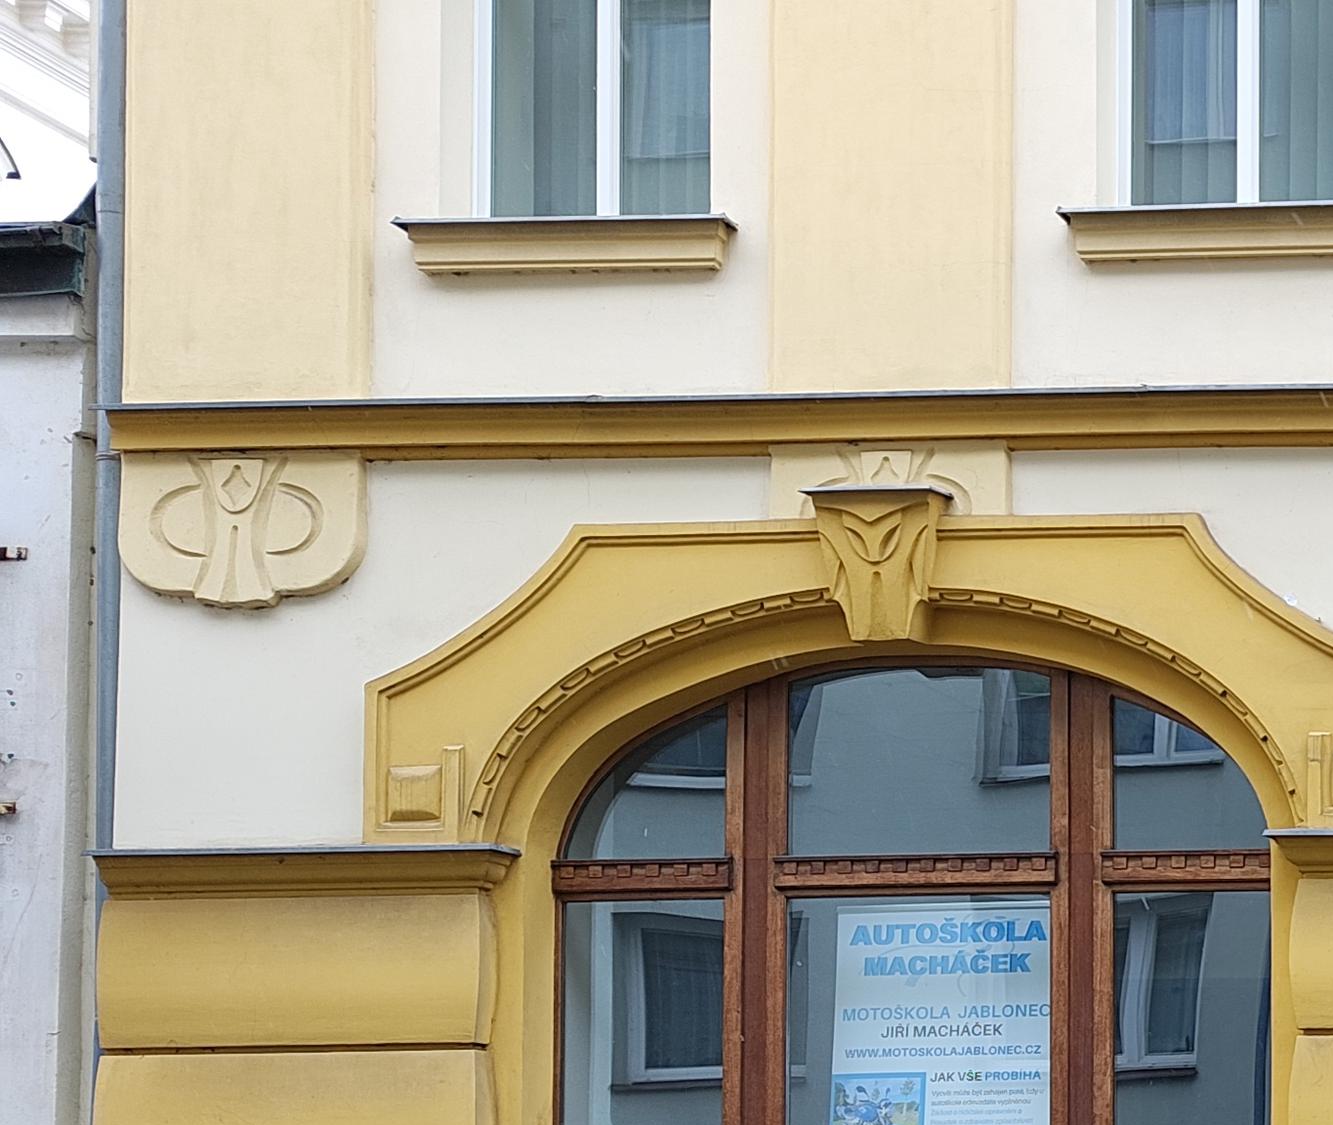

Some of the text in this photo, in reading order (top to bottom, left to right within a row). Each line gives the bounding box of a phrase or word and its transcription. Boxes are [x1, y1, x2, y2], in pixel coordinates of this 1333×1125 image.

[850, 918, 1047, 946] AUTOŠKOLA
[864, 949, 1031, 976] MACHÁČEK
[842, 1004, 1050, 1021] MOTOŠKOLA JABLONEC
[881, 1022, 1002, 1038] JIŘÍ MACHÁČEK
[844, 1045, 1041, 1058] WWW.MOTOSKOLAJABLONEC.CZ
[930, 1072, 954, 1082] JAK
[958, 1070, 982, 1081] VŠE
